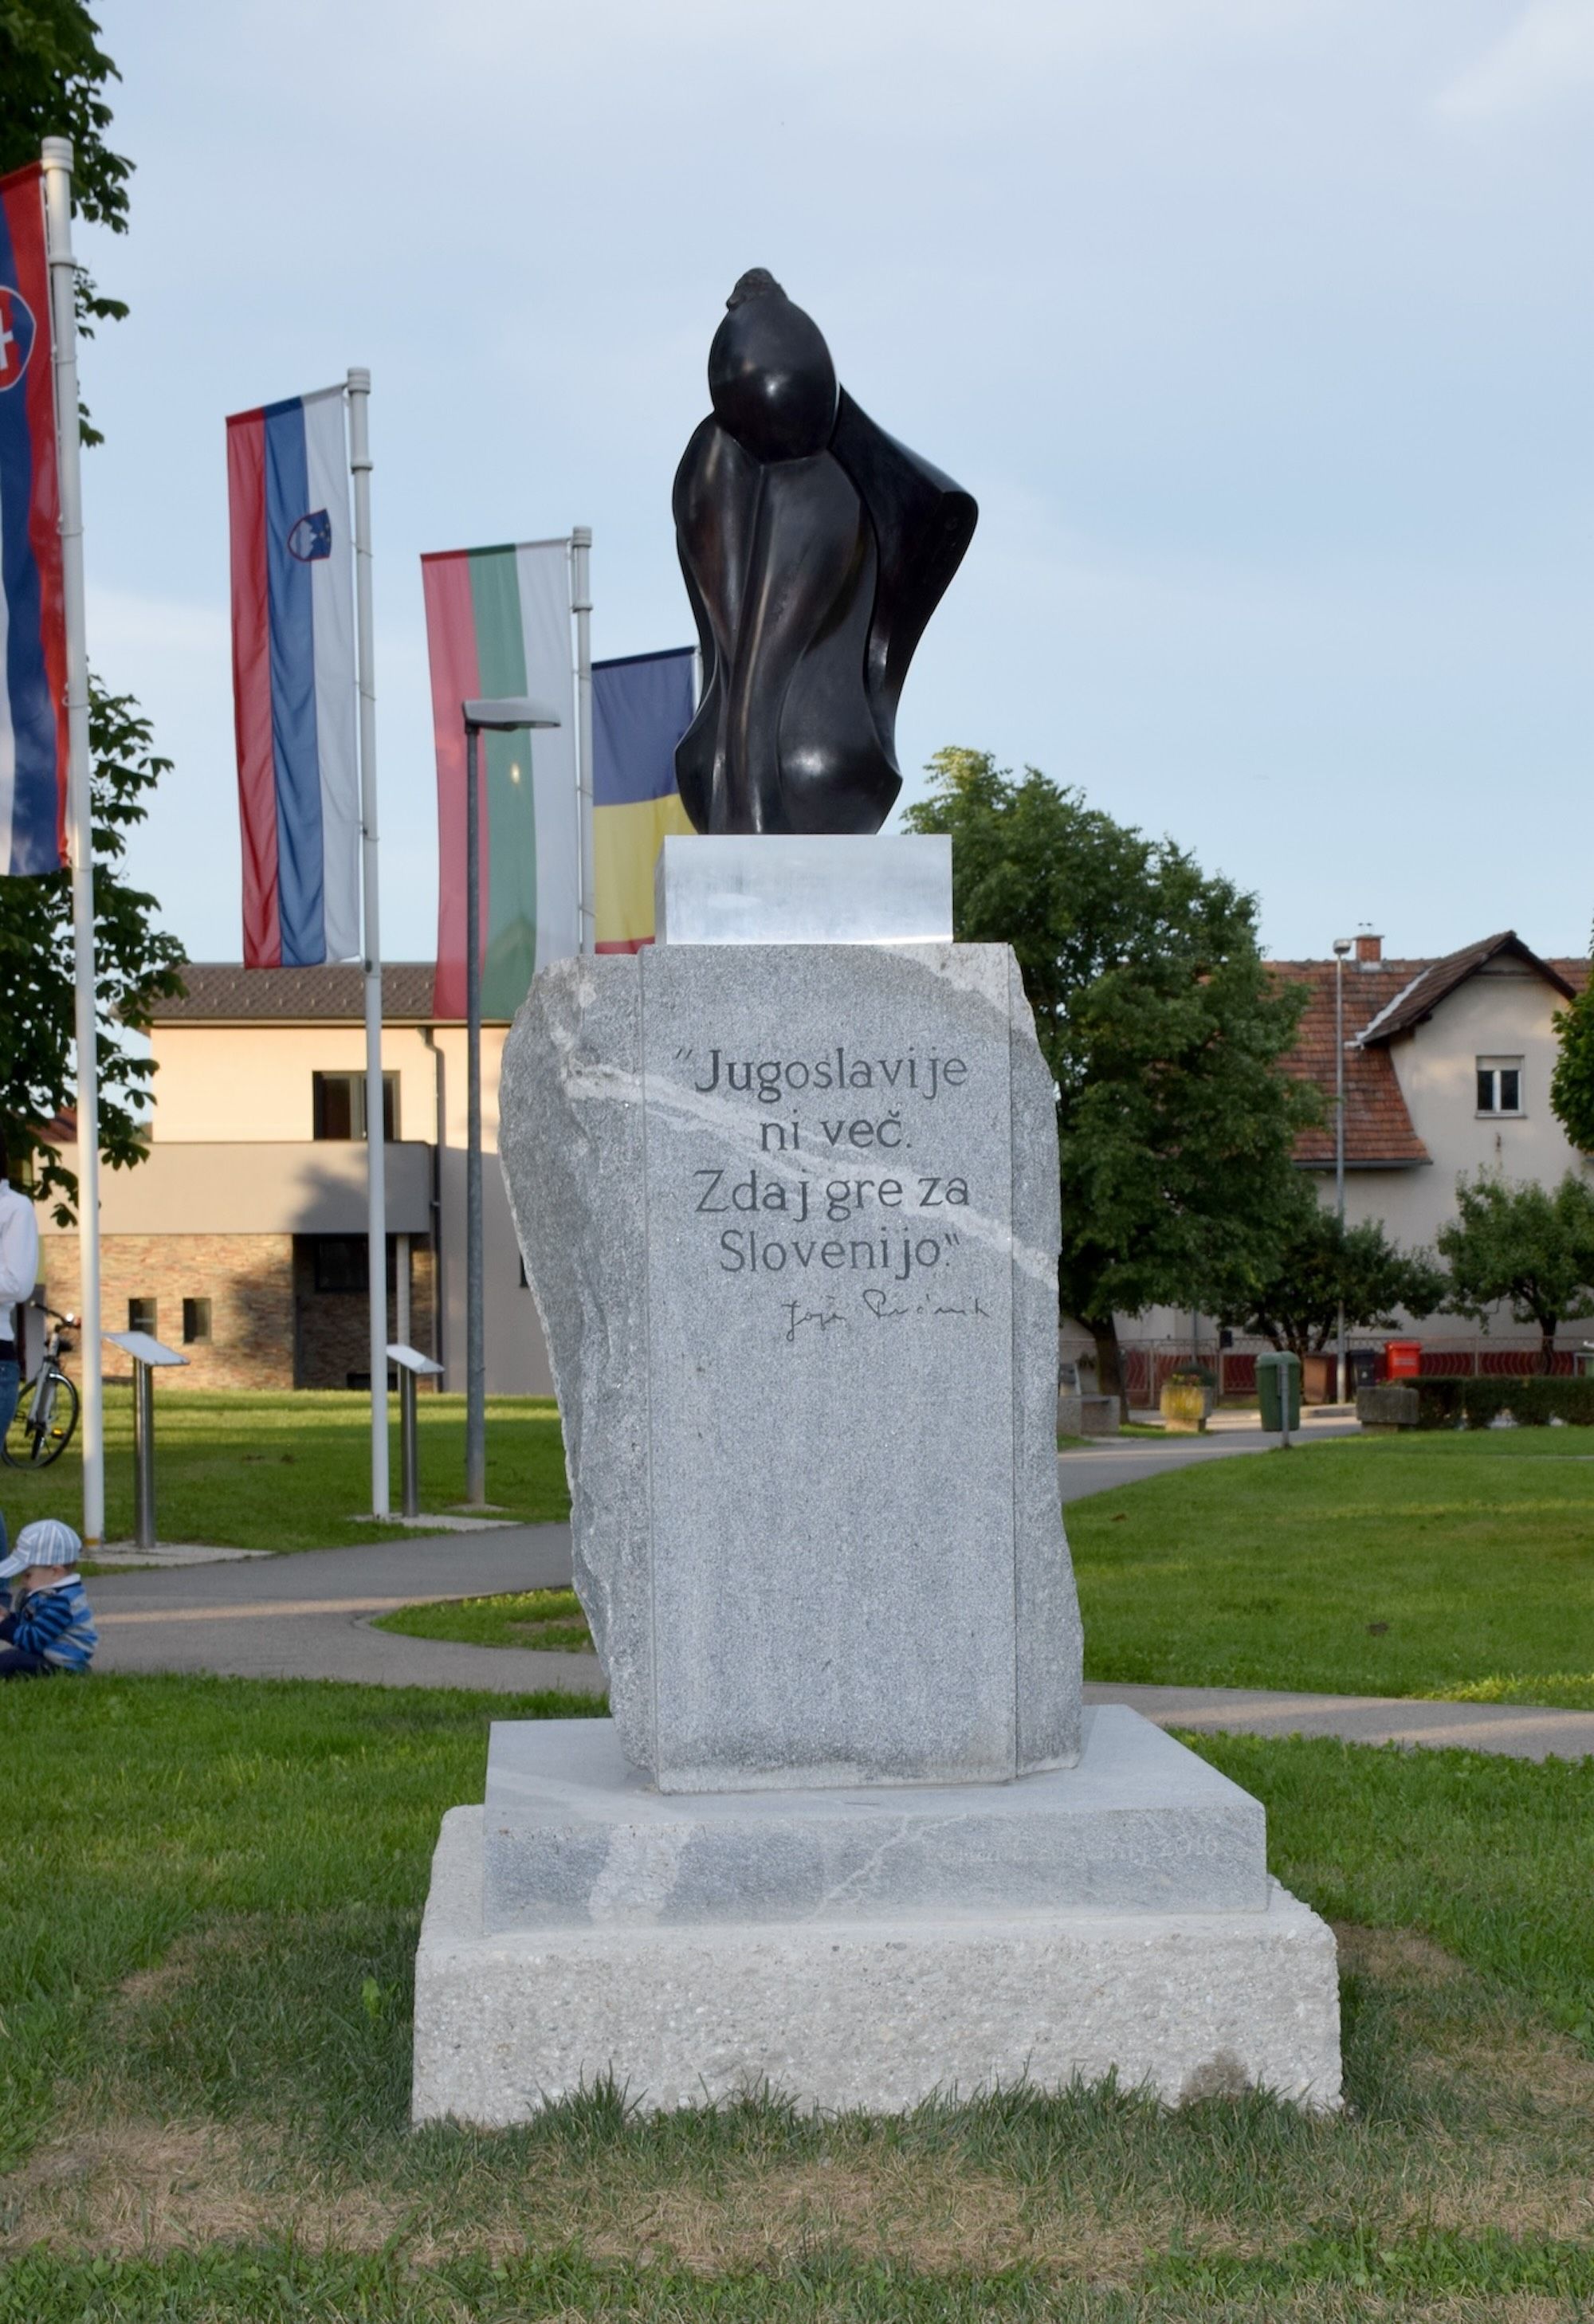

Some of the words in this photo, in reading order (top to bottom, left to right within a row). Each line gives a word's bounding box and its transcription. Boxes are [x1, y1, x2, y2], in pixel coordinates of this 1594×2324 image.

[760, 1109, 801, 1151] ni
[819, 1109, 913, 1150] več.
[693, 1168, 810, 1223] Zdaj
[826, 1177, 904, 1223] gre
[917, 1176, 970, 1208] za
